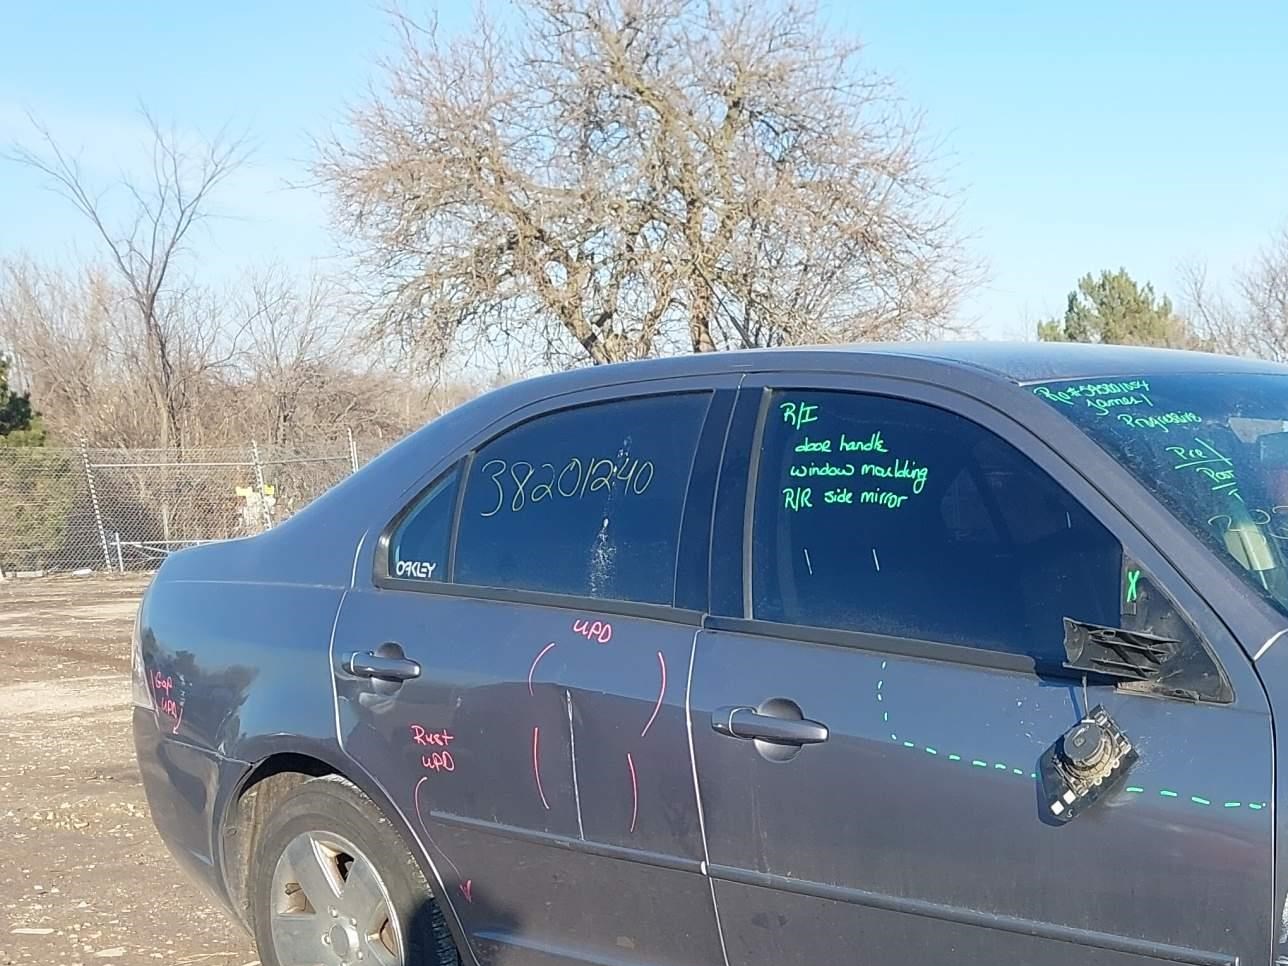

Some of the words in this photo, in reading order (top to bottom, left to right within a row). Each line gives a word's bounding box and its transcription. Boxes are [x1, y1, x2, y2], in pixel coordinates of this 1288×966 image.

[780, 402, 819, 430] R/I
[839, 430, 890, 453] handle
[479, 458, 656, 517] 38201240
[790, 461, 856, 478] window
[861, 458, 929, 495] moulding
[782, 486, 814, 512] R/R
[823, 487, 854, 504] side
[860, 487, 909, 509] mirror
[396, 561, 438, 579] OAKLEY
[411, 725, 455, 746] Rust
